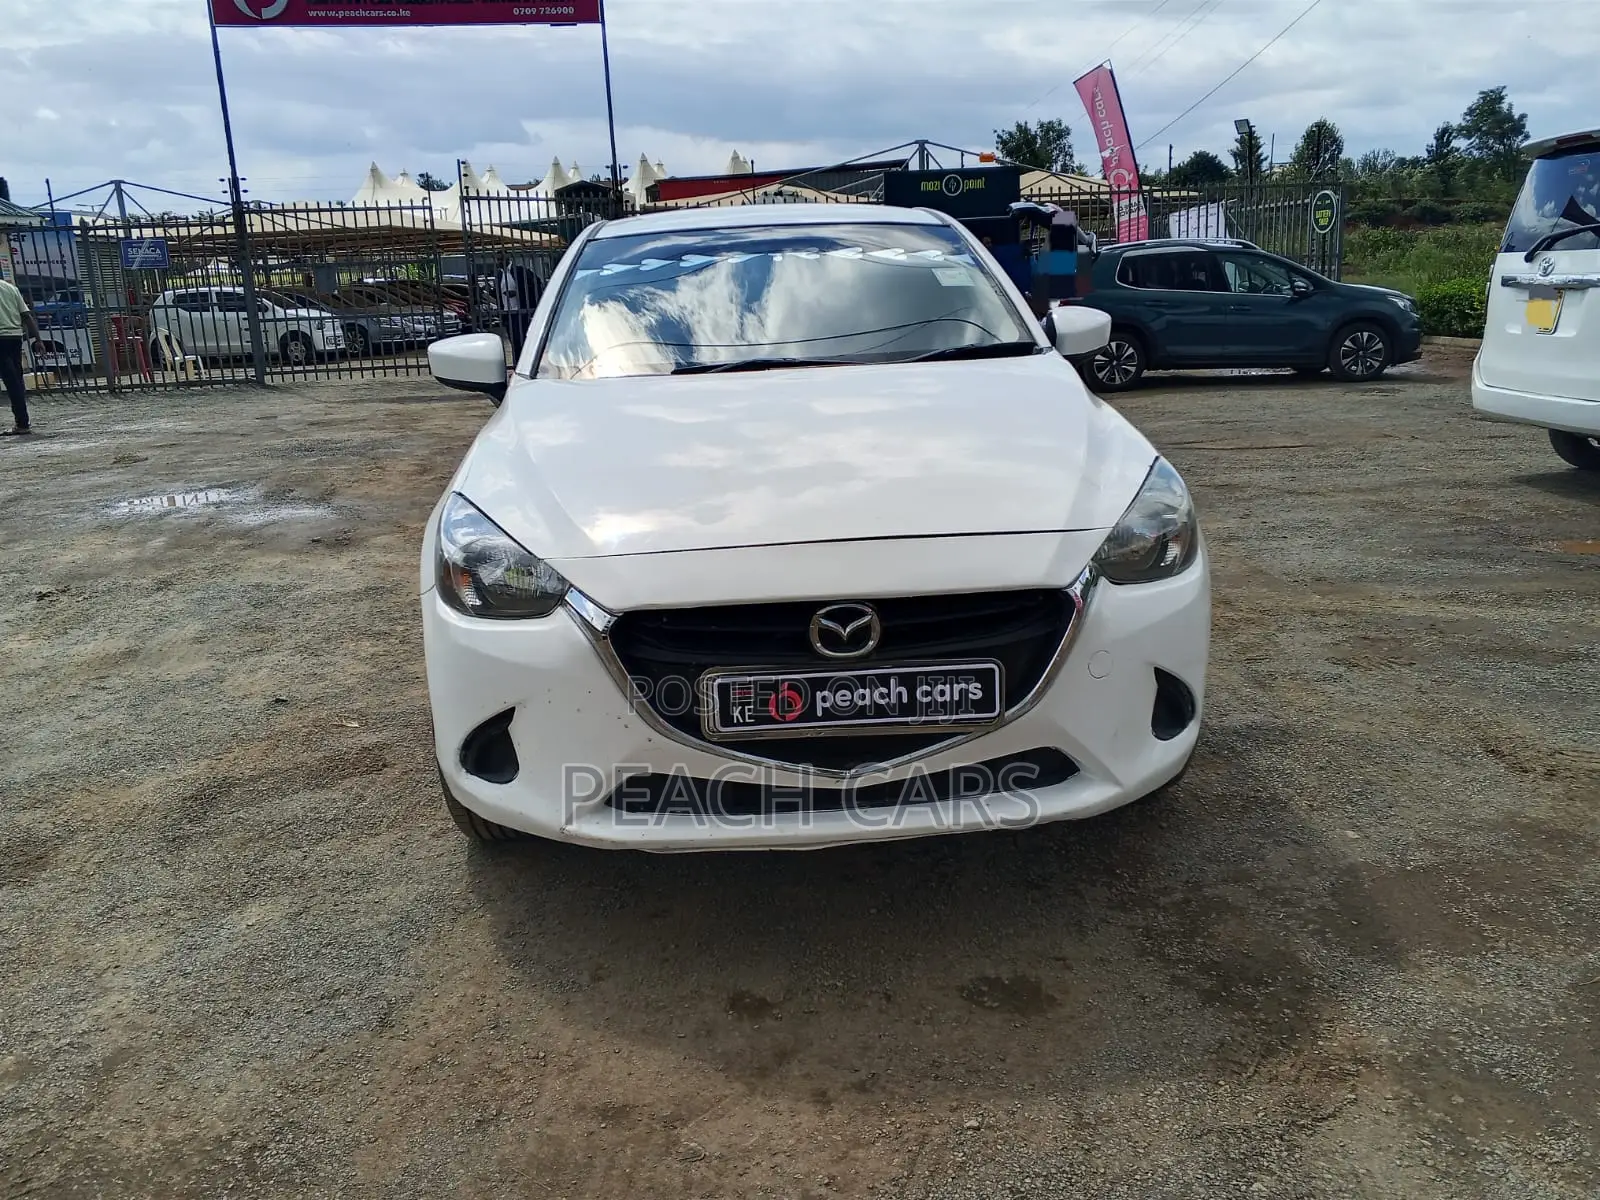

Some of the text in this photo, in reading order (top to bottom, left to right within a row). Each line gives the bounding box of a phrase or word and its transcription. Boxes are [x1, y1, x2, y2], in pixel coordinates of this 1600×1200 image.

[307, 8, 411, 18] www.peachcars.co.ke
[540, 7, 575, 15] 726900
[963, 176, 985, 193] point
[816, 678, 983, 717] peach cars
[733, 705, 756, 723] KE
